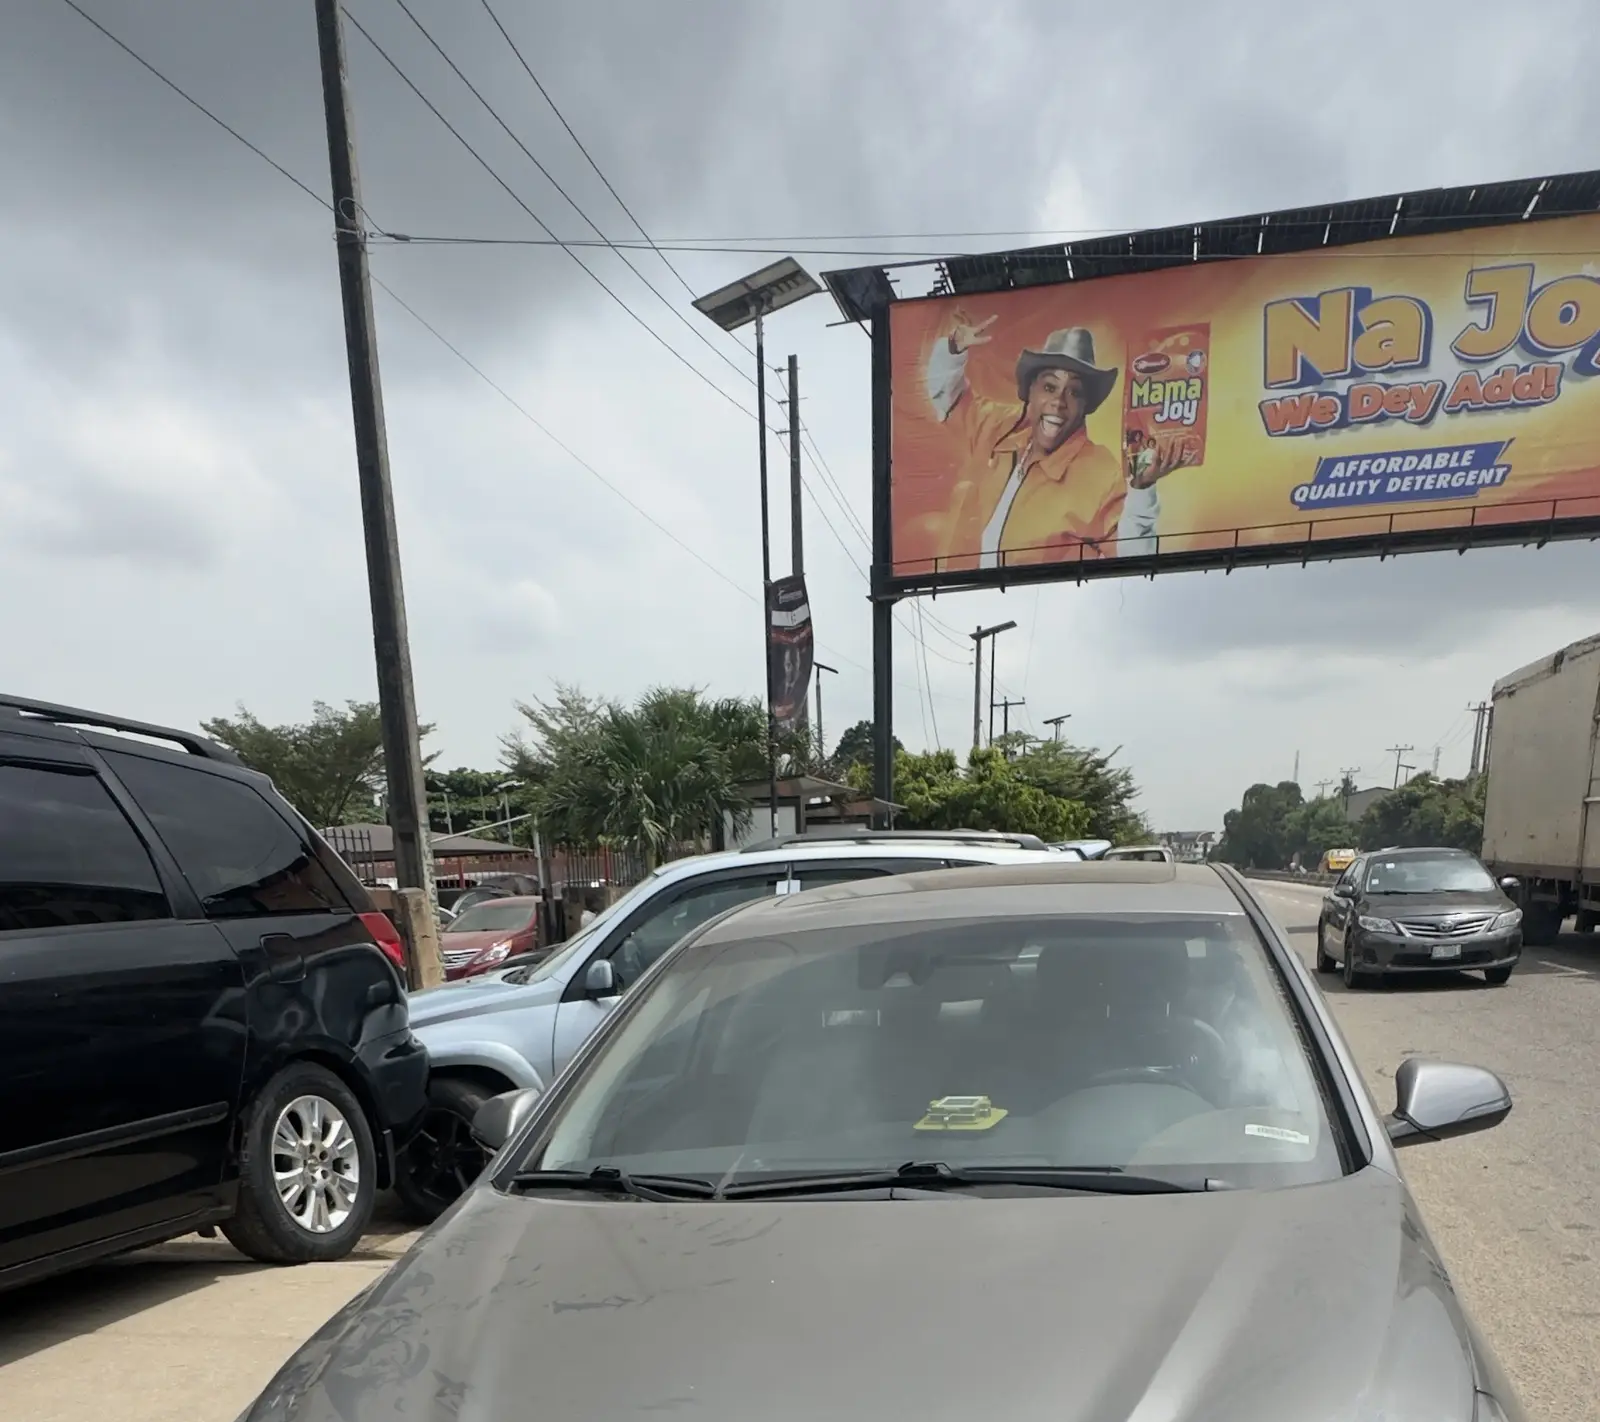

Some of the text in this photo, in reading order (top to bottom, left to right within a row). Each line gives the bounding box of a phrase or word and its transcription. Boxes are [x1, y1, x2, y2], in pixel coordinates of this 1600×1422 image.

[1264, 263, 1600, 389] Na Jo
[1131, 377, 1203, 408] Mama
[1259, 362, 1564, 436] We Dey Add!
[1153, 399, 1199, 426] Joy
[1329, 450, 1475, 479] AFFORDABLE
[1294, 467, 1508, 503] QUALITY DETERGENT
